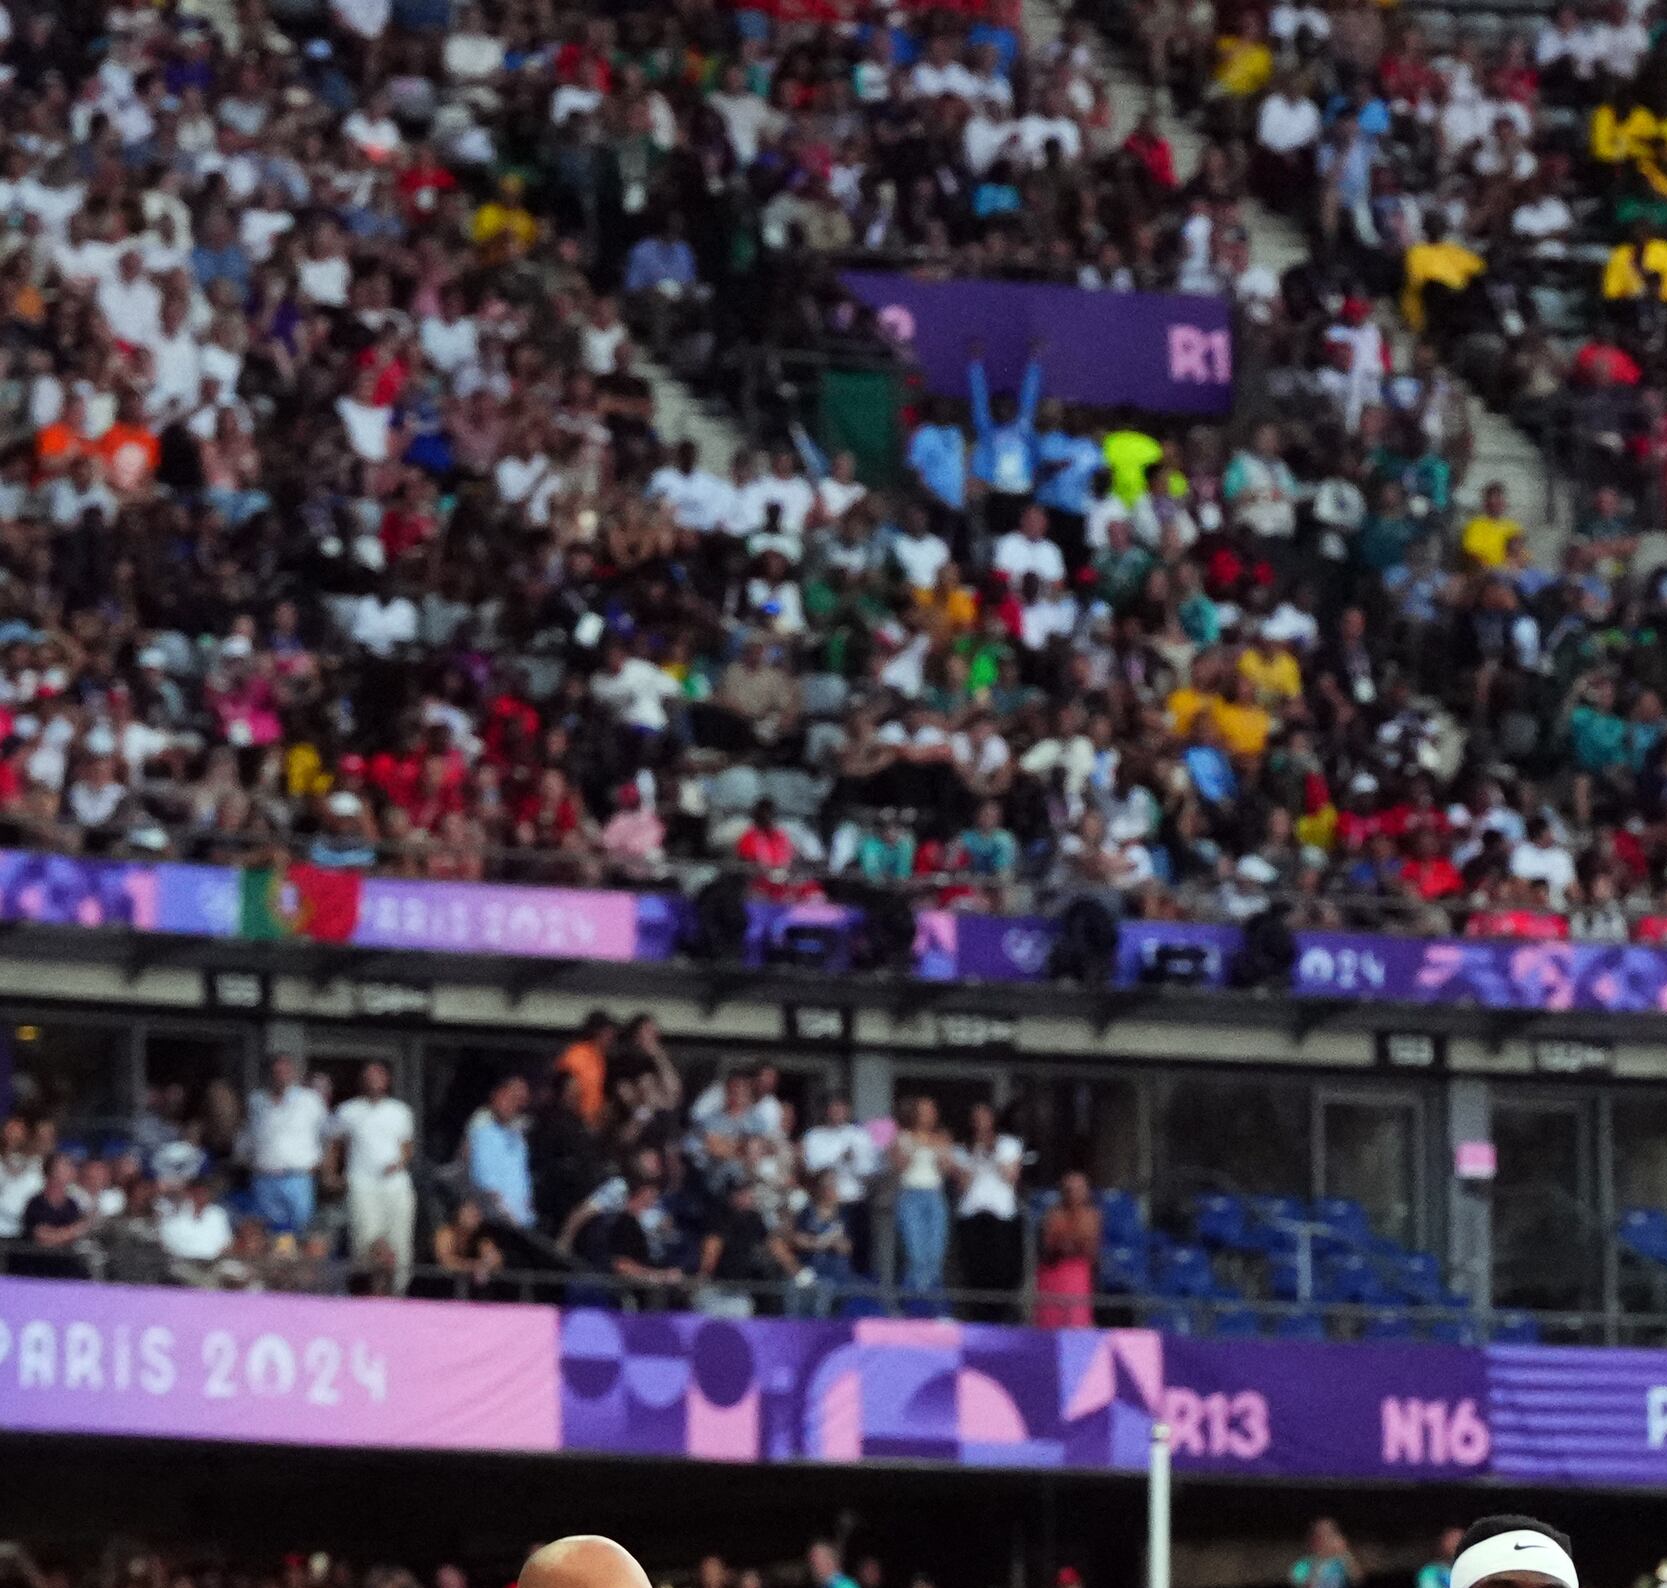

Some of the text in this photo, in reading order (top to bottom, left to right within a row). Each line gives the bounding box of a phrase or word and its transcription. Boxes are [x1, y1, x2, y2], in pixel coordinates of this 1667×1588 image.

[1298, 948, 1386, 988] 024
[200, 1331, 387, 1405] 2024
[1163, 1386, 1270, 1460] R13
[1383, 1395, 1489, 1467] N16
